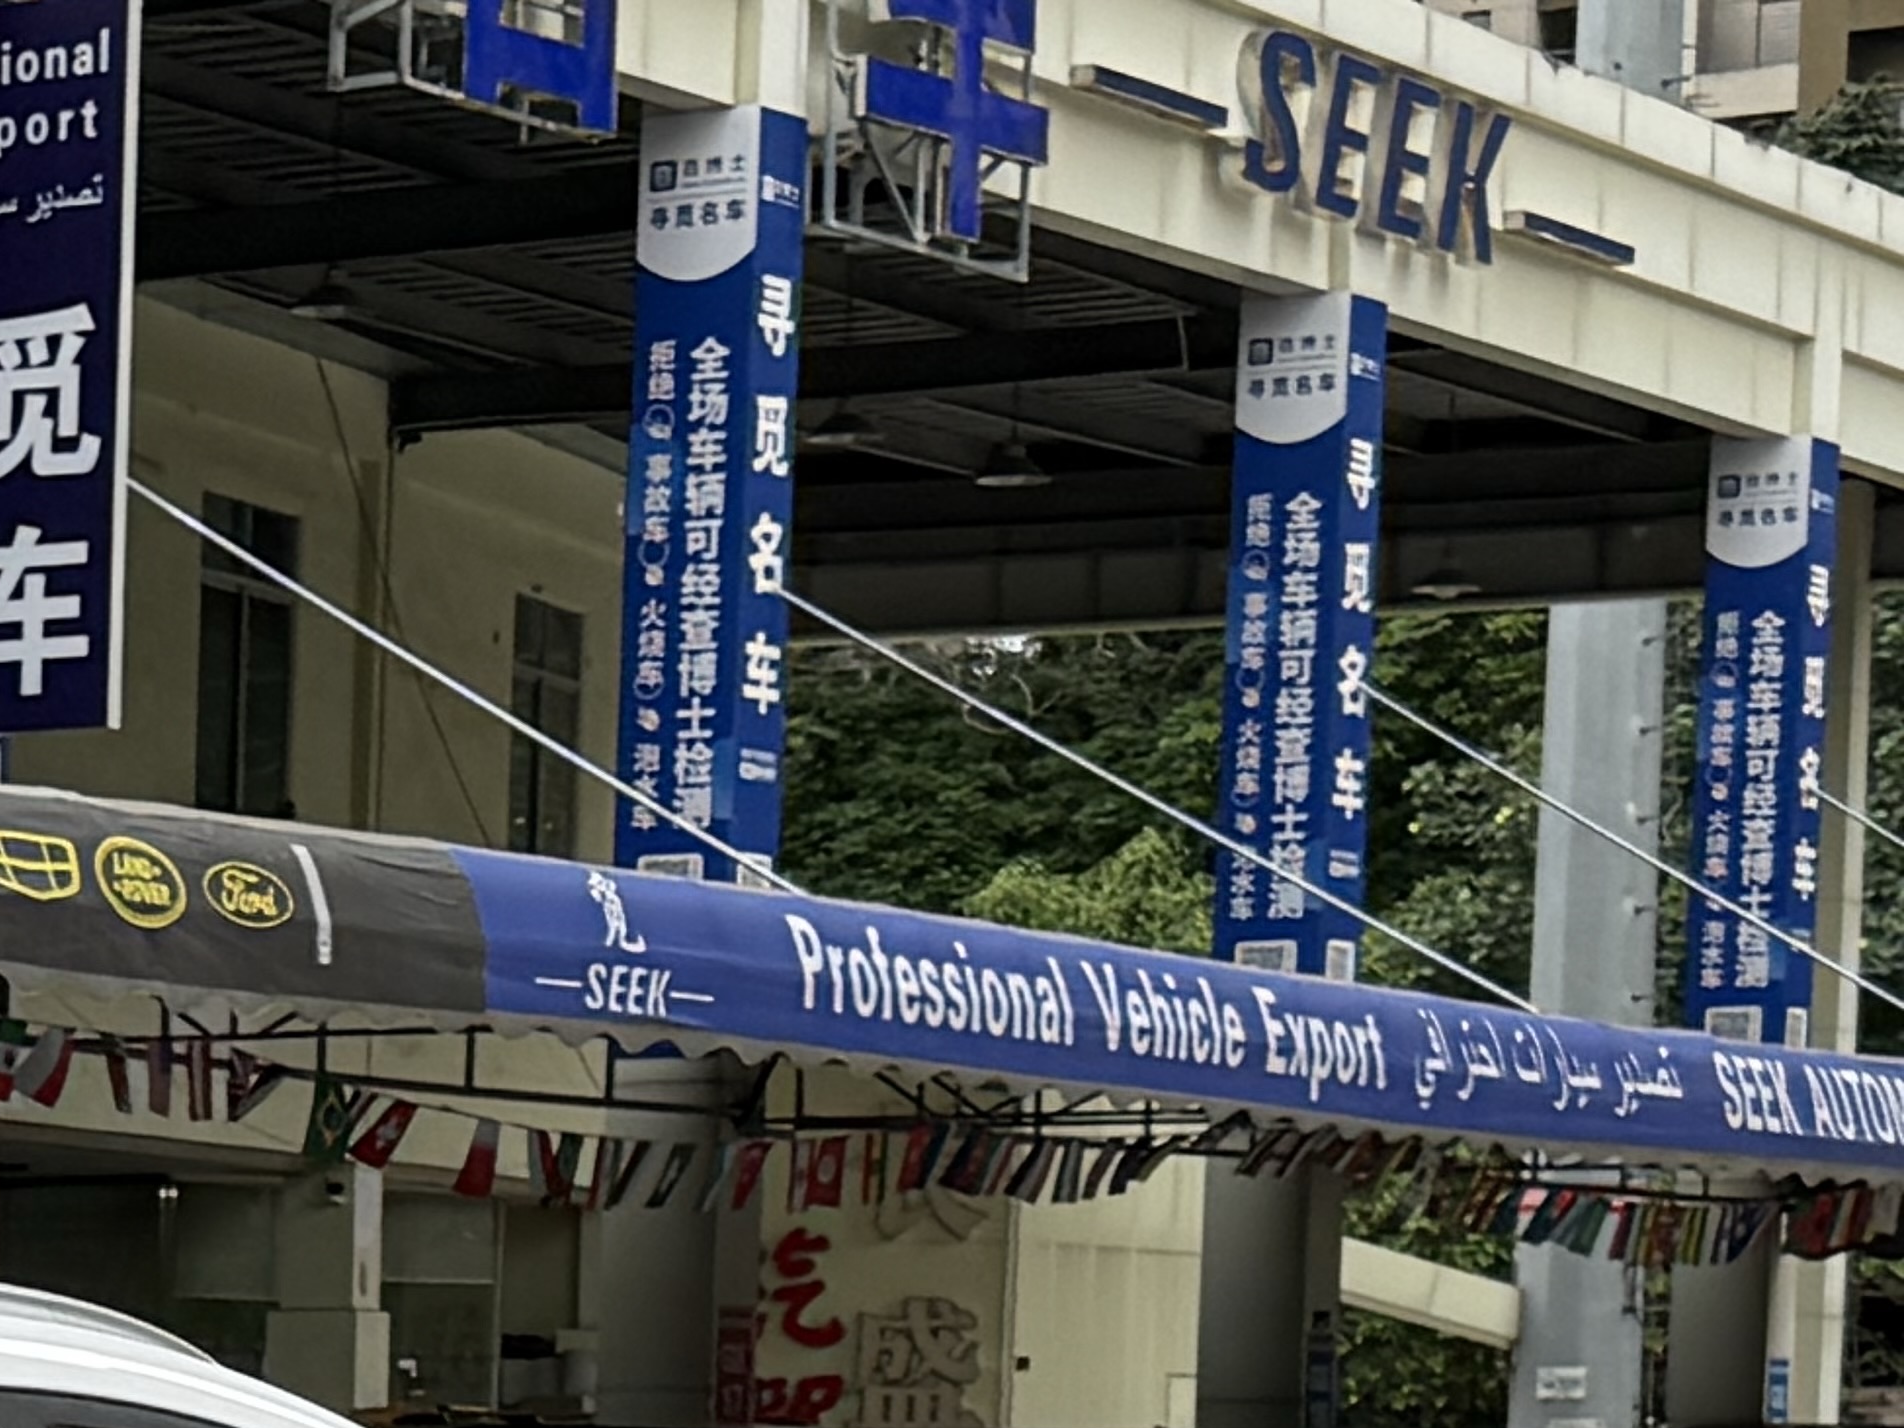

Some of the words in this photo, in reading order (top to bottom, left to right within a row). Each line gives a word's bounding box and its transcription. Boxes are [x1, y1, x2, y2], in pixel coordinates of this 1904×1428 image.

[1242, 30, 1512, 265] SEEK
[741, 275, 795, 716] 寻觅名车
[585, 963, 672, 1017] SEEK
[784, 912, 1076, 1047] Professional
[1081, 960, 1248, 1069] Vehicle
[1252, 985, 1388, 1103] Export
[1712, 1051, 1804, 1136] SEEK
